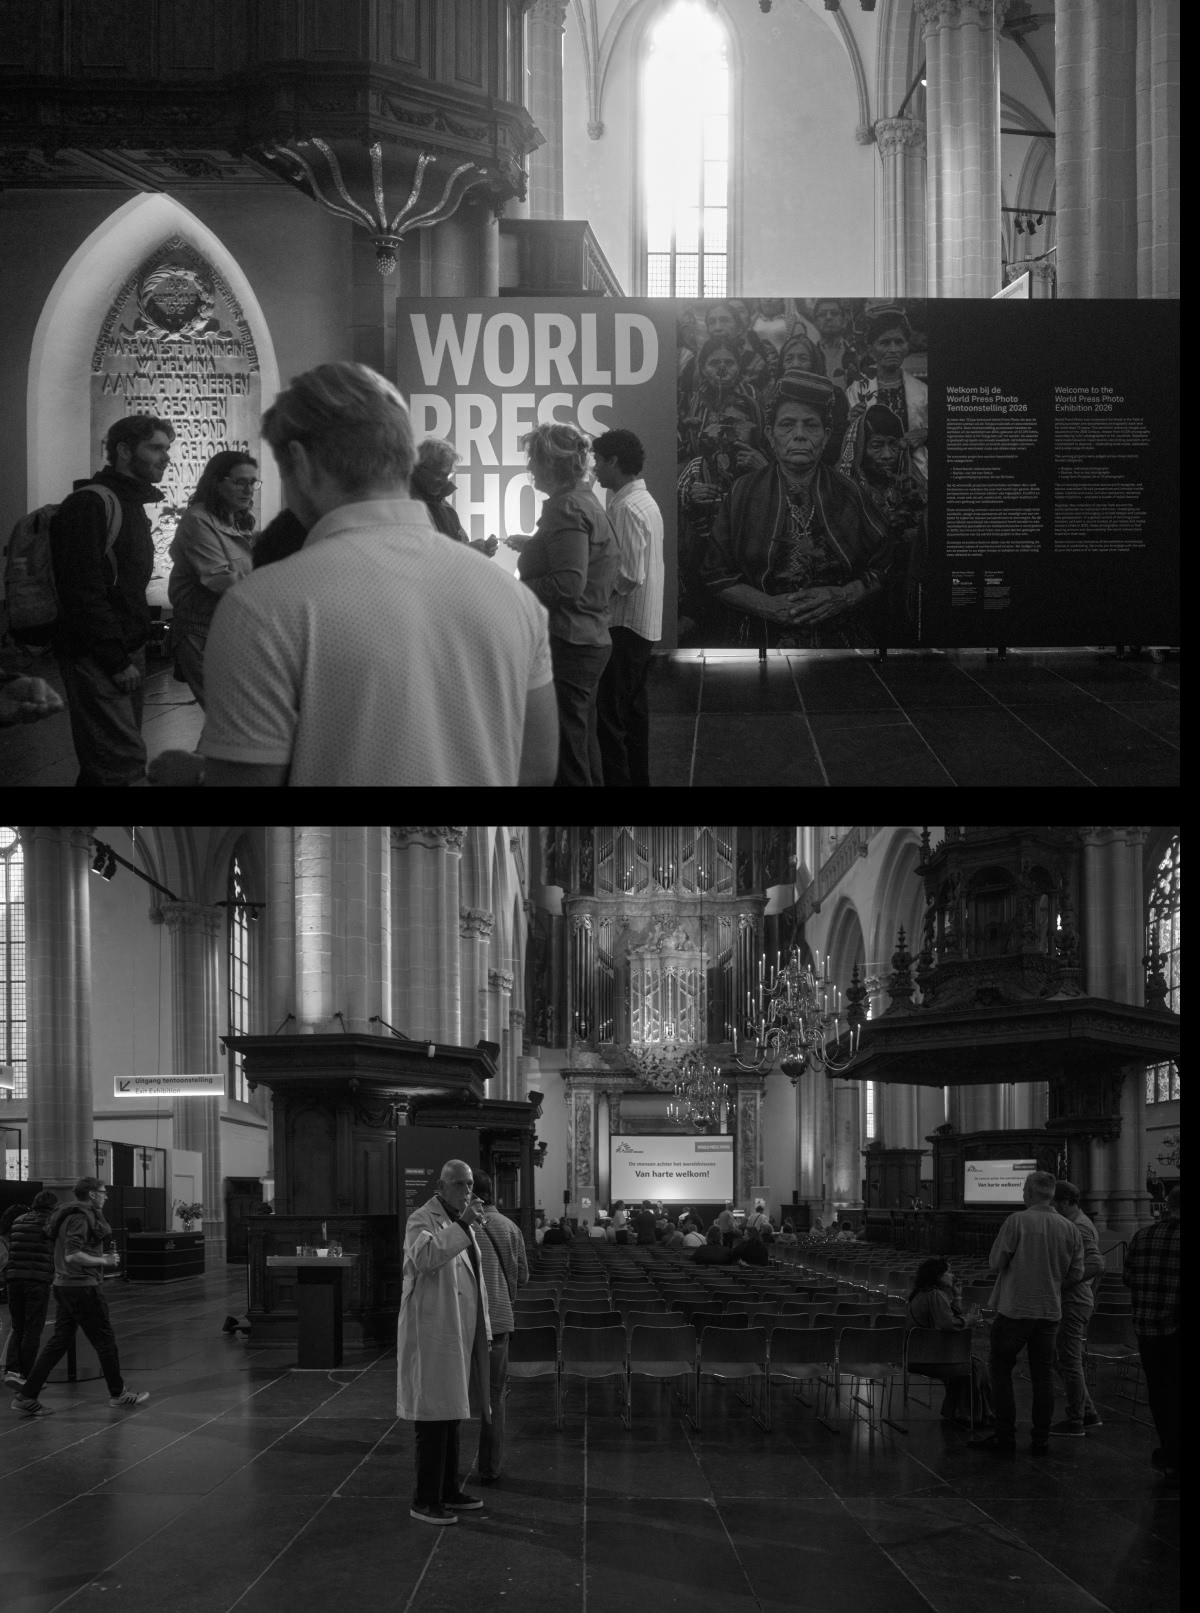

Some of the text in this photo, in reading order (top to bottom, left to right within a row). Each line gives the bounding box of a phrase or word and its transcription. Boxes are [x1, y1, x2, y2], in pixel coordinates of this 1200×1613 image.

[409, 313, 659, 387] WORLD
[946, 386, 1002, 397] Welkom bij de
[1055, 386, 1090, 394] Welcome
[1101, 386, 1114, 394] the
[946, 395, 1019, 403] World Press Photo
[1055, 395, 1125, 403] World Press Photo
[946, 404, 1028, 413] Tentoonstelling 2026
[1055, 404, 1113, 412] Exhibition 2026
[135, 1076, 213, 1085] Uitgang tentoonstelling
[635, 1170, 710, 1178] Van harte welkom!
